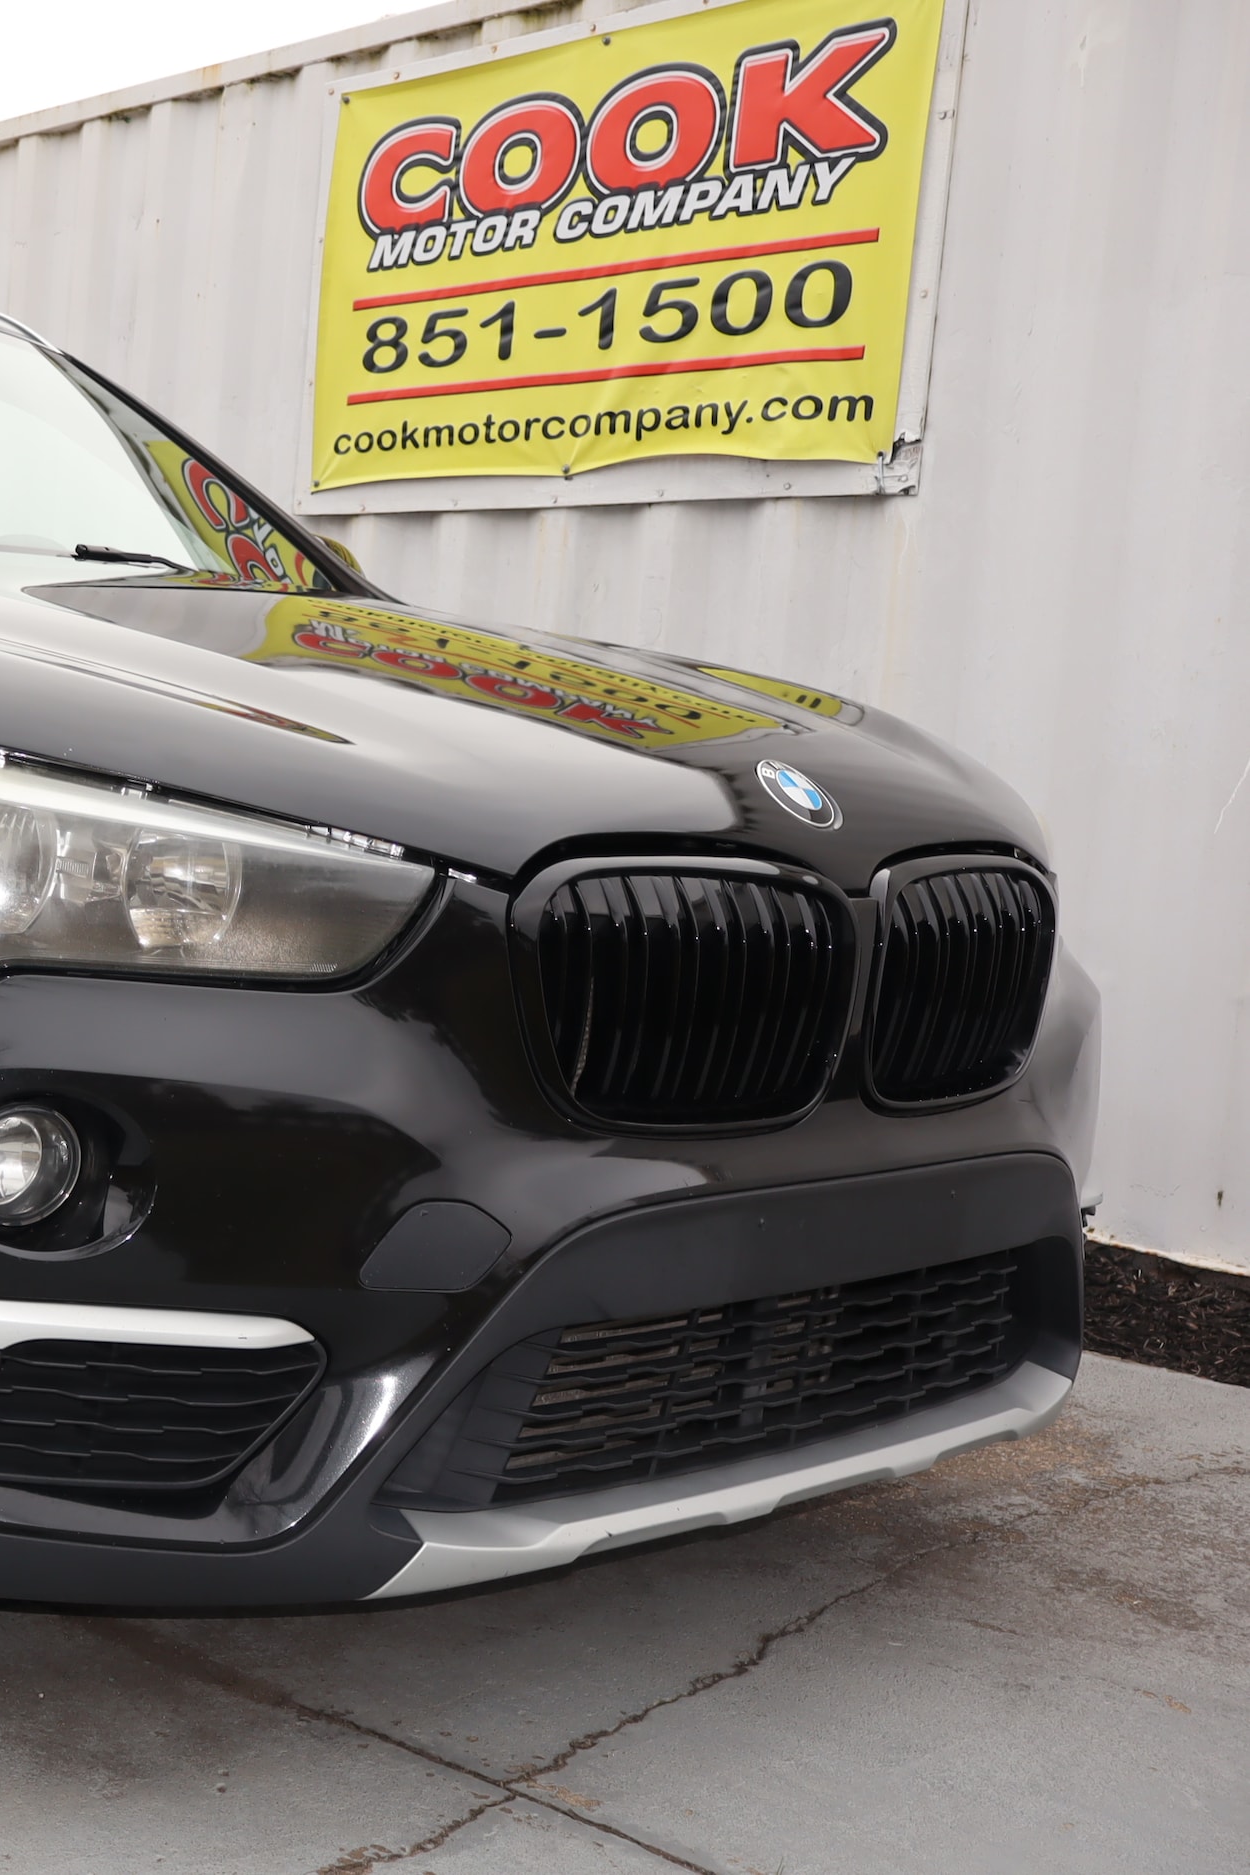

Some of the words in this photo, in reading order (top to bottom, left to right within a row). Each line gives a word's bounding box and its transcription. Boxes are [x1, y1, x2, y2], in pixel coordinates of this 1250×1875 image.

[358, 18, 896, 233] COOK
[367, 209, 542, 272] MOTOR
[553, 157, 856, 243] COMPANY
[361, 259, 853, 375] 851-1500
[332, 393, 875, 456] cookmotorcompany.com
